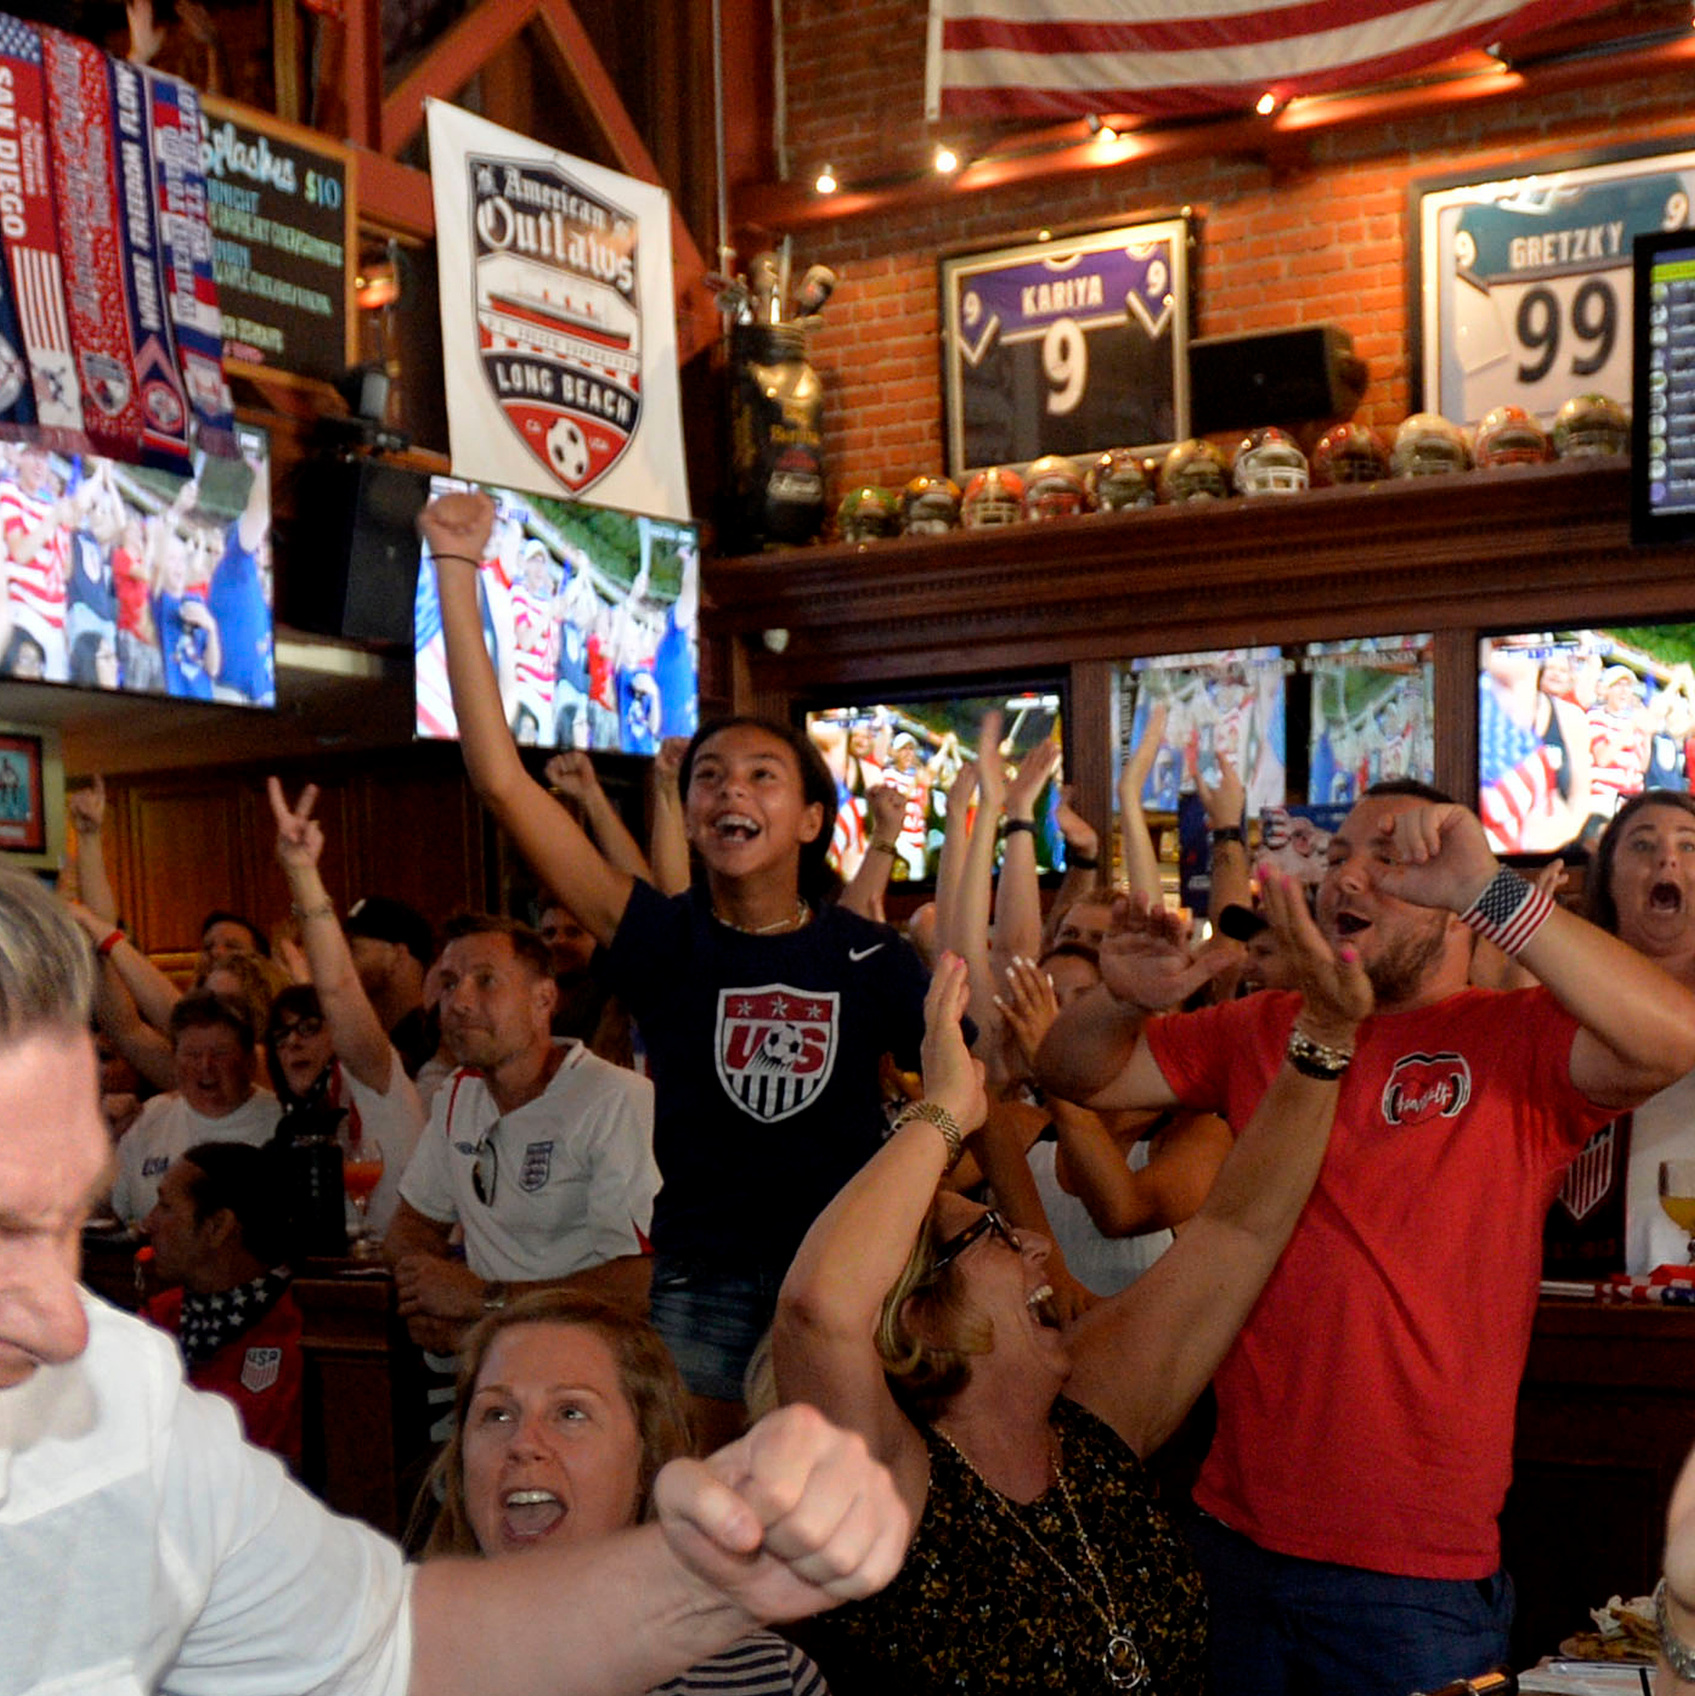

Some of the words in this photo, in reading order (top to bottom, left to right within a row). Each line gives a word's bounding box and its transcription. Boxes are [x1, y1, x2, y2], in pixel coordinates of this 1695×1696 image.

[504, 164, 607, 231] American
[476, 196, 634, 291] Outlaws
[1509, 220, 1624, 271] GRETZKY
[1021, 274, 1104, 318] KARIYA
[1146, 259, 1168, 297] 9
[1516, 277, 1619, 384] 99
[495, 362, 554, 396] LONG
[561, 375, 631, 424] BEACH
[1043, 317, 1088, 416] 9
